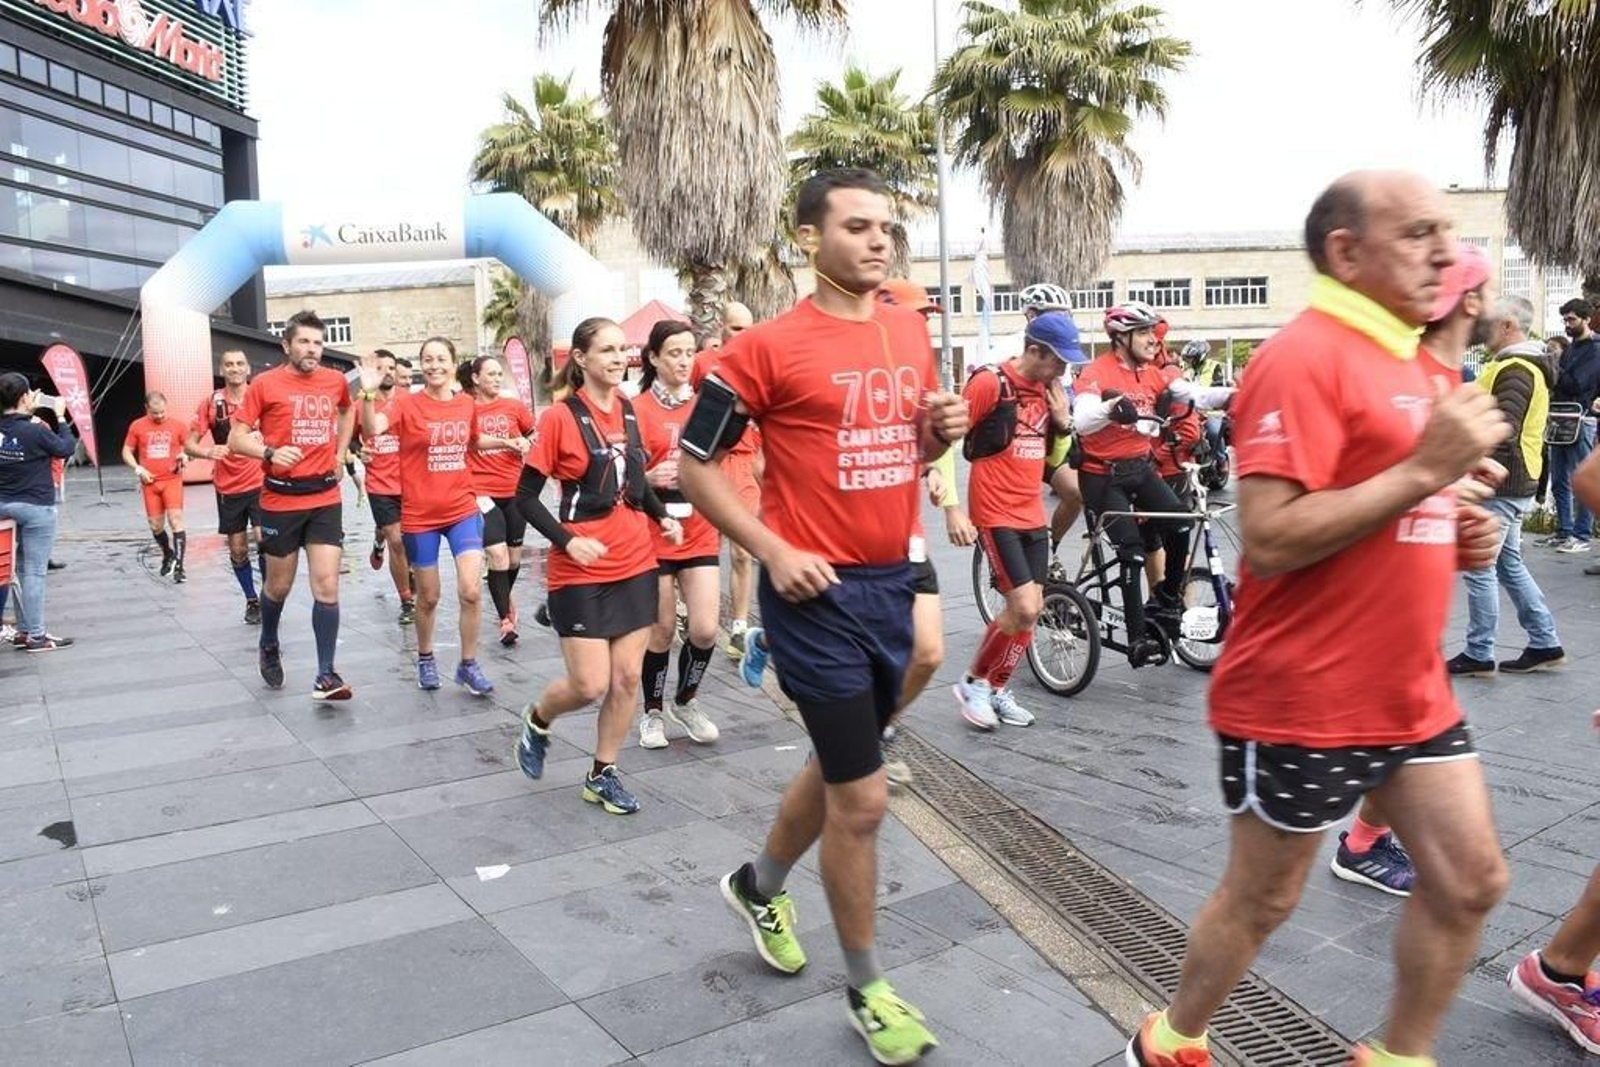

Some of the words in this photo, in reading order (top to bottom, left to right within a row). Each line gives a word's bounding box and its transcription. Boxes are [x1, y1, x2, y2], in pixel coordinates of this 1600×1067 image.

[338, 222, 448, 245] CaixaBank
[288, 394, 332, 419] 700
[831, 366, 920, 426] 700
[427, 420, 469, 446] 700
